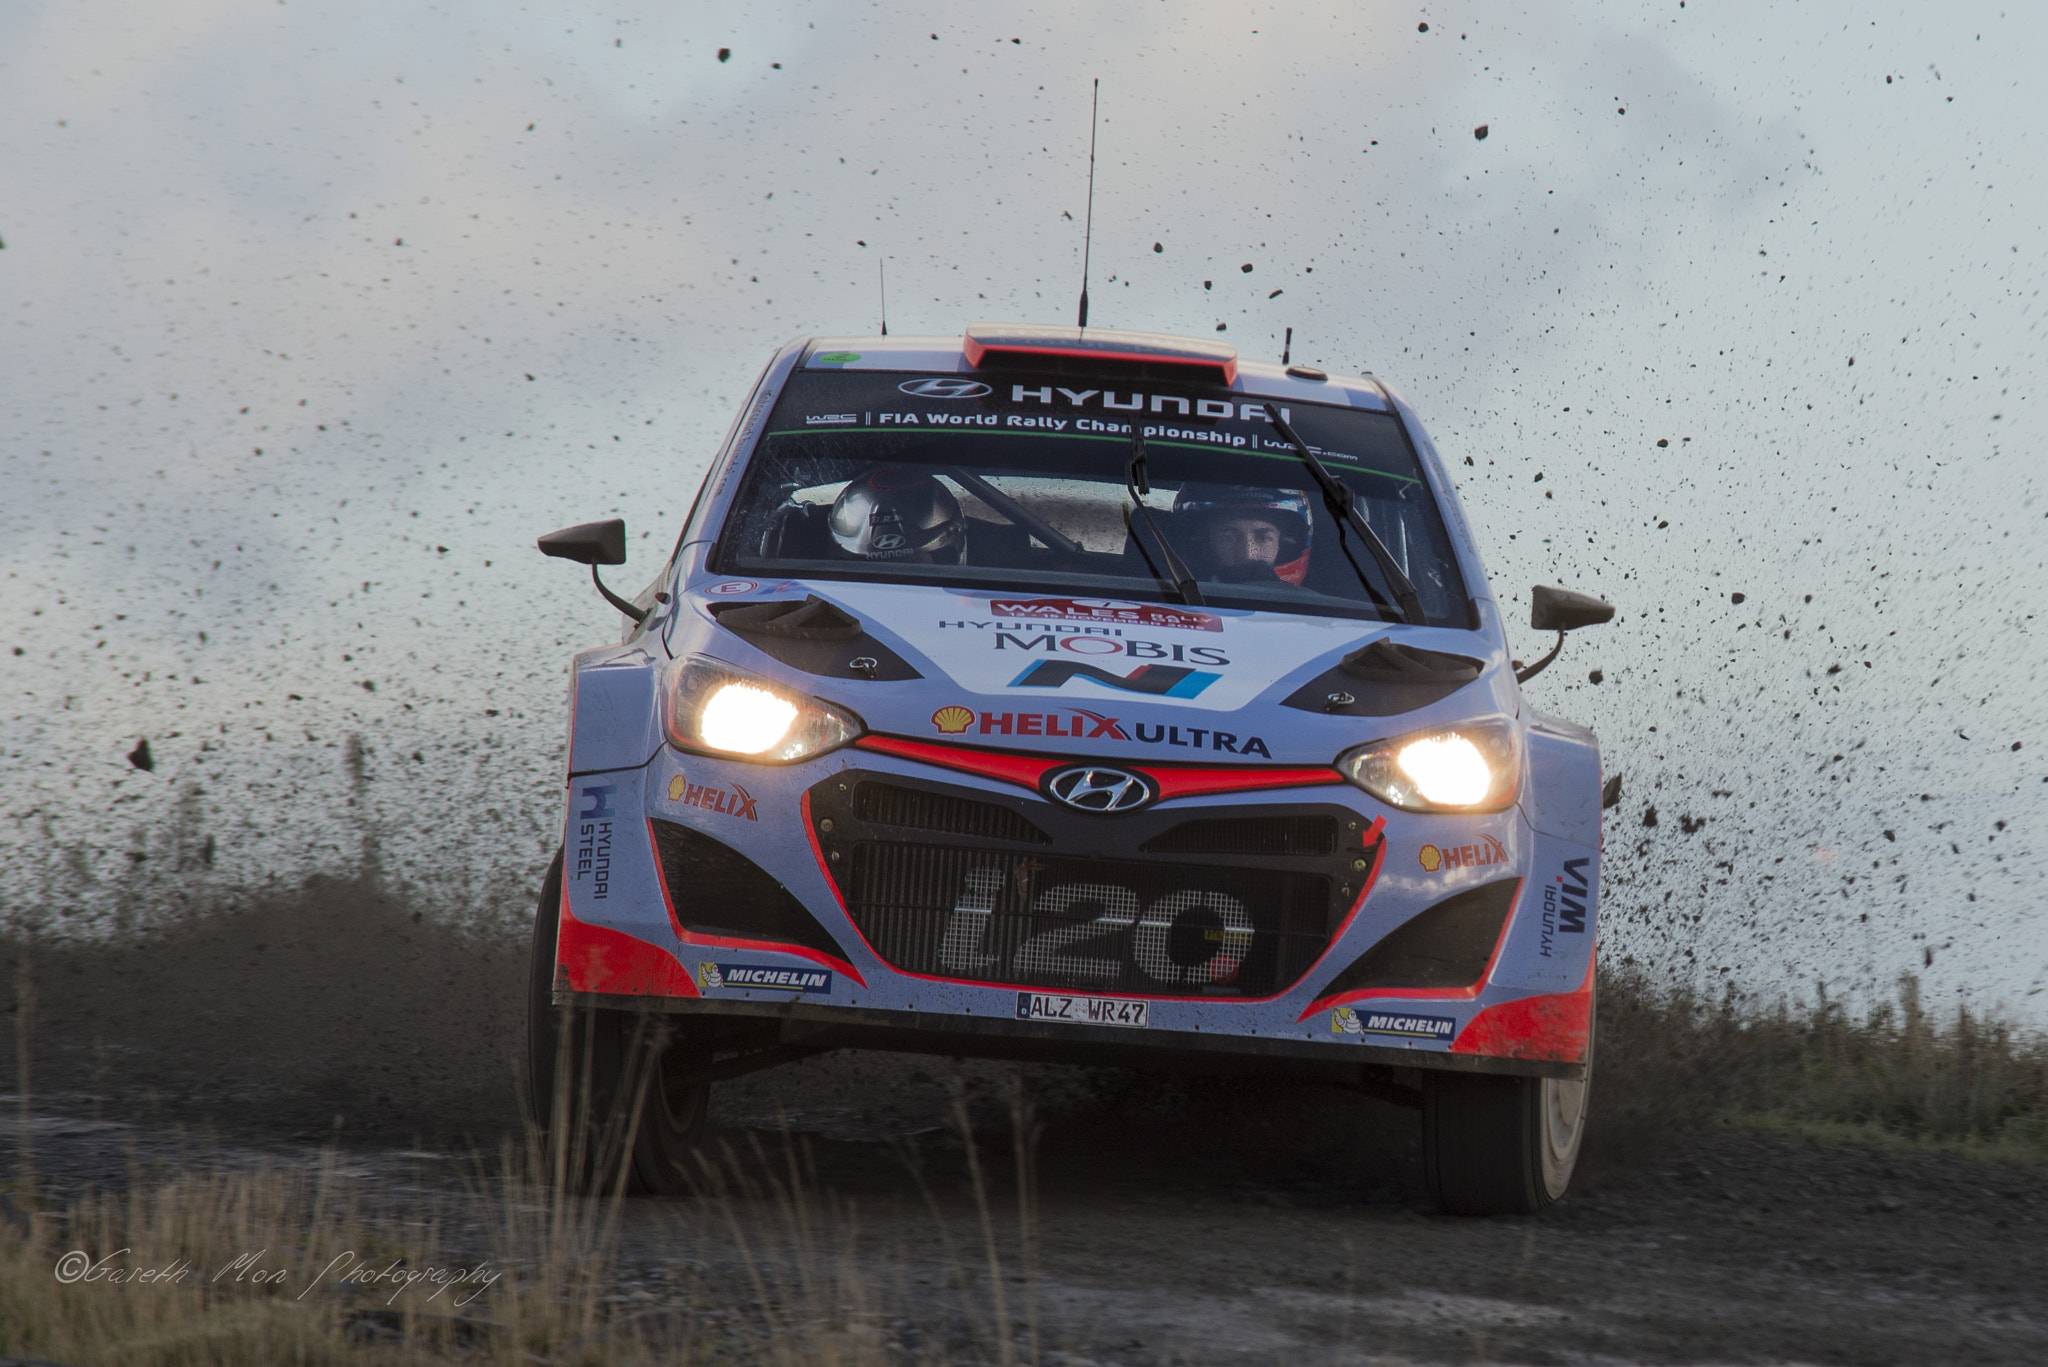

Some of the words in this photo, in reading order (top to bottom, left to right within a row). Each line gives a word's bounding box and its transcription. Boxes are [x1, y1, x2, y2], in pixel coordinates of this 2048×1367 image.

[879, 413, 919, 424] FIA
[926, 413, 998, 425] World
[1006, 415, 1067, 431] Rally
[1011, 384, 1291, 425] HYUNDAI
[938, 620, 1122, 637] HYUNDAI
[996, 603, 1140, 620] WALES
[993, 632, 1231, 667] MOBIS
[978, 707, 1132, 742] HELIX
[1135, 722, 1273, 760] ULTRA
[684, 781, 759, 822] HELIX
[577, 823, 595, 881] STEEL
[593, 821, 613, 900] HYUNDAI
[1441, 832, 1510, 871] HELIX
[1555, 857, 1591, 934] WIA
[1539, 884, 1558, 958] HYUNDAI
[726, 968, 827, 988] MICHELIN
[1030, 996, 1074, 1019] ALZ
[1366, 1014, 1454, 1035] MICHELIN
